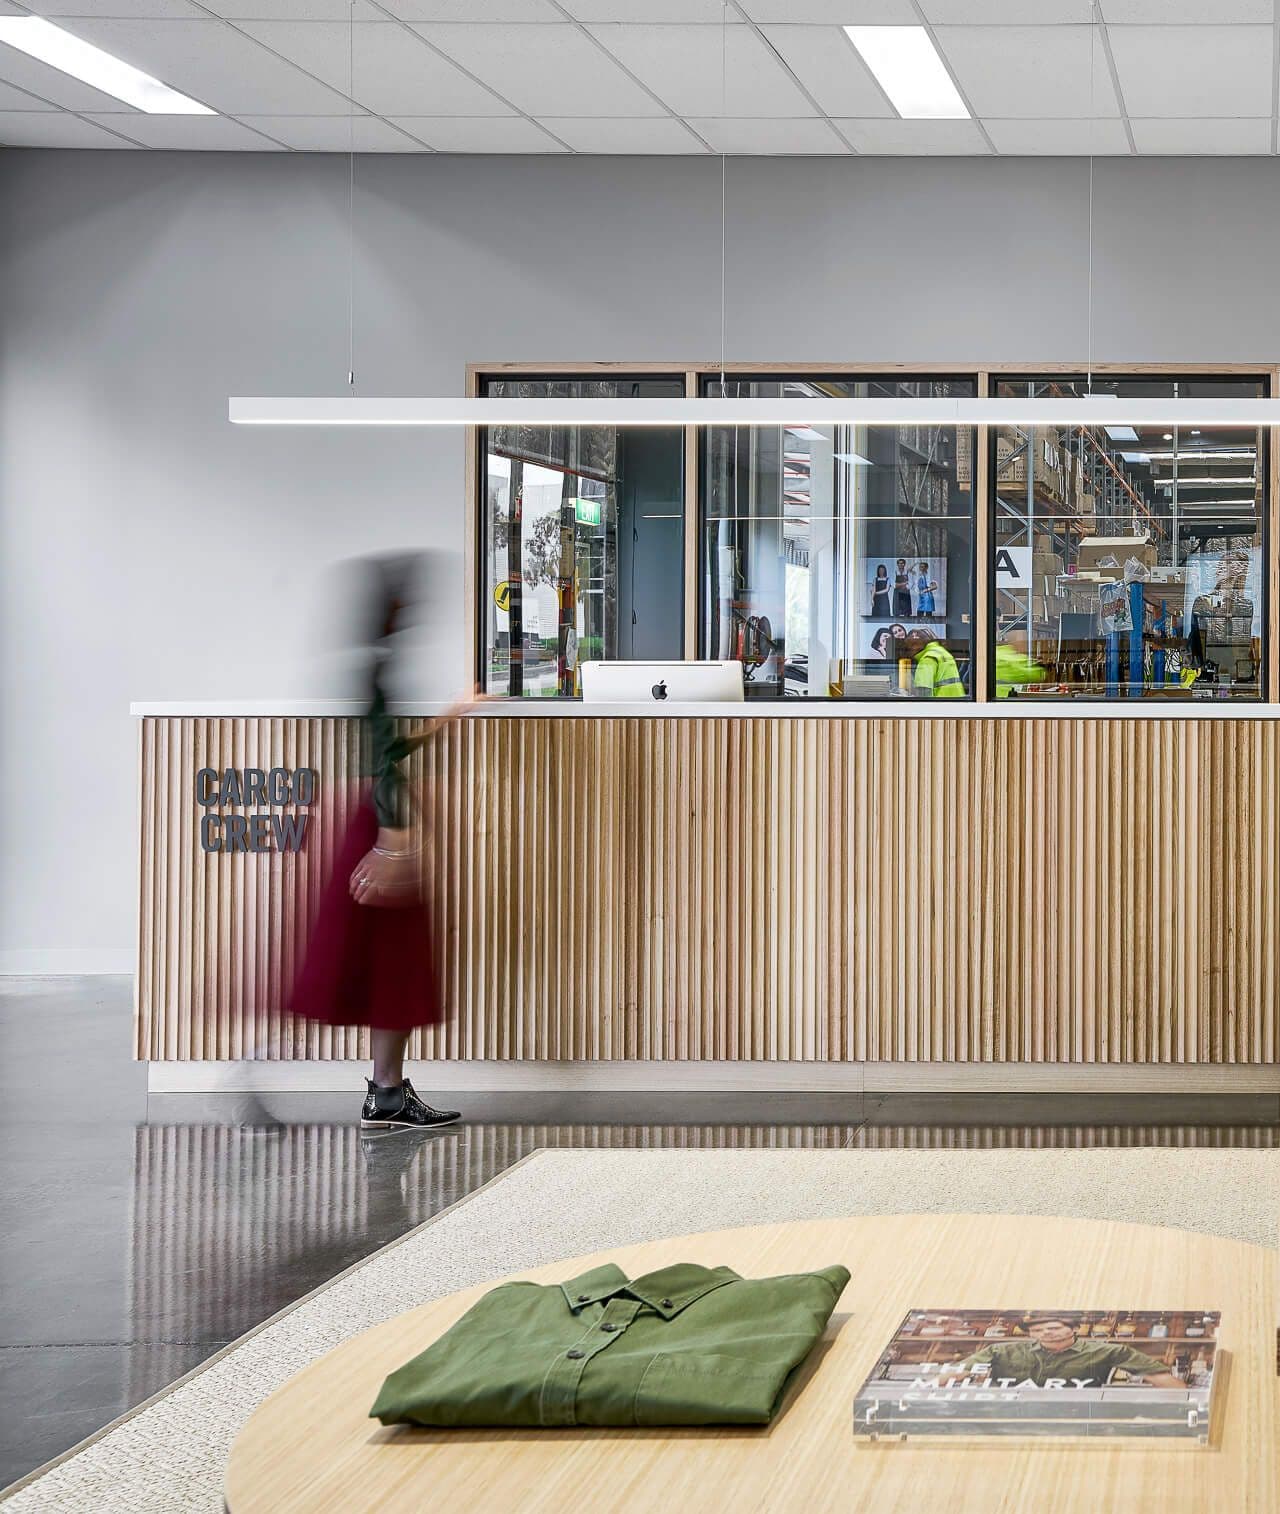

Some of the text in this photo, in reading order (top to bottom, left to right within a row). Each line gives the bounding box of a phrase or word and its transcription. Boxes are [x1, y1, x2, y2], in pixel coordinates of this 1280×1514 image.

[996, 549, 1020, 578] A
[197, 768, 313, 806] CARGO
[201, 814, 307, 852] CREW
[919, 1362, 993, 1374] THE
[908, 1377, 1094, 1390] MILITARY
